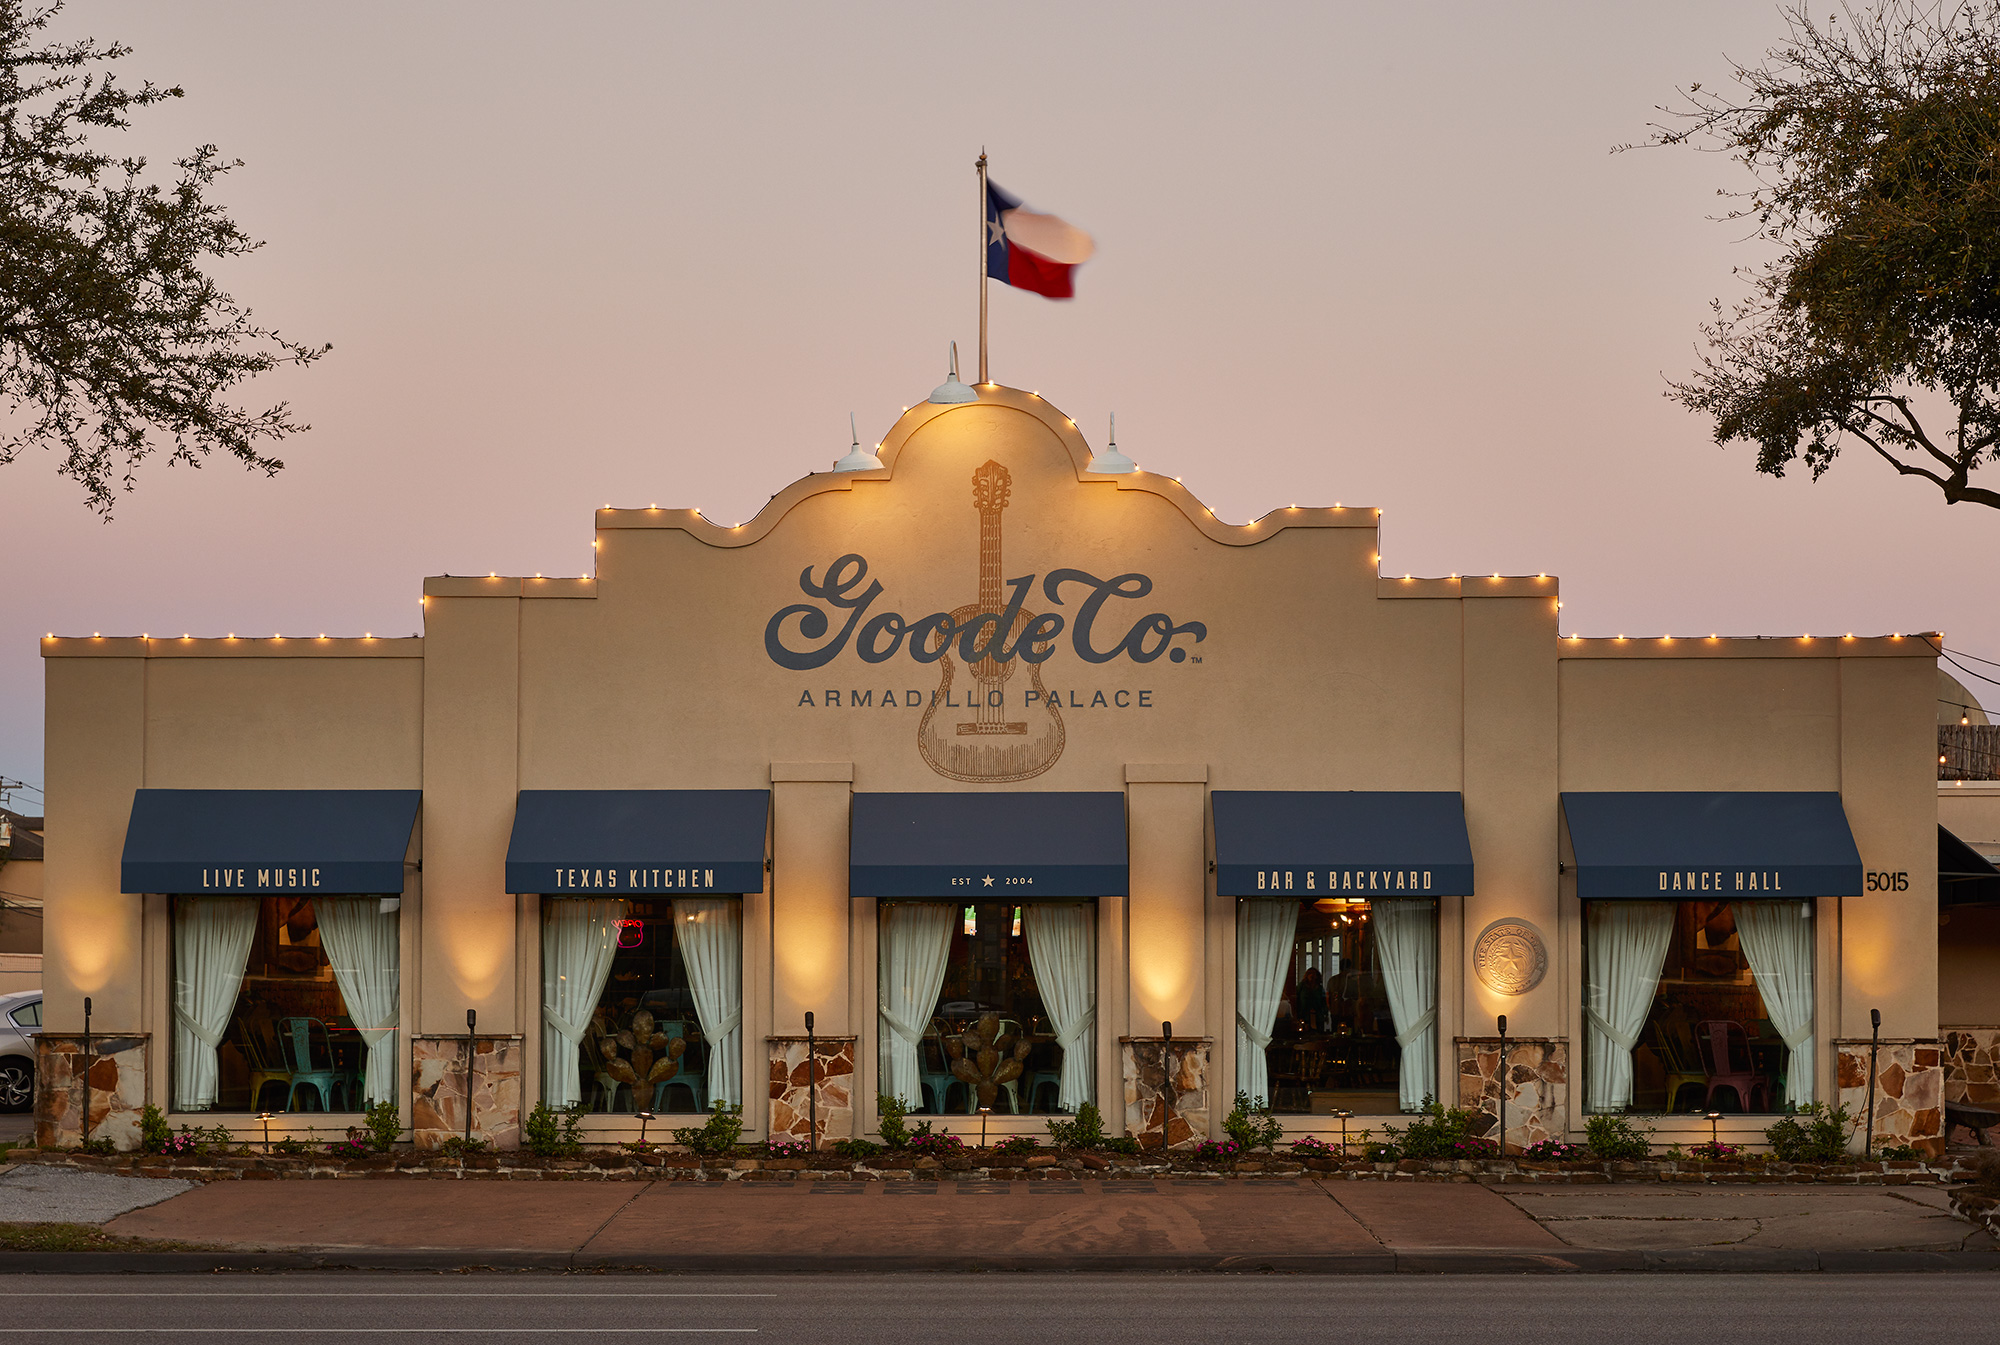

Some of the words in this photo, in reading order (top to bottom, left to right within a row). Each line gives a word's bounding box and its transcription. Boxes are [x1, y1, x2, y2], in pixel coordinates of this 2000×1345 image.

[764, 554, 1065, 671] Goode
[798, 689, 1005, 708] ARMADILLO
[1024, 689, 1154, 708] PALACE
[202, 868, 246, 888] LIVE
[257, 868, 321, 888] MUSIC
[555, 869, 618, 888] TEXAS
[629, 869, 715, 888] KITCHEN
[951, 877, 971, 886] EST
[1005, 877, 1034, 886] 2004
[1257, 871, 1294, 890] BAR
[1306, 871, 1316, 890] &
[1329, 871, 1433, 890] BACKYARD
[1658, 871, 1722, 891] DANCE
[1735, 871, 1782, 891] HALL
[1866, 871, 1910, 893] 5015
[1484, 927, 1511, 946] STATE
